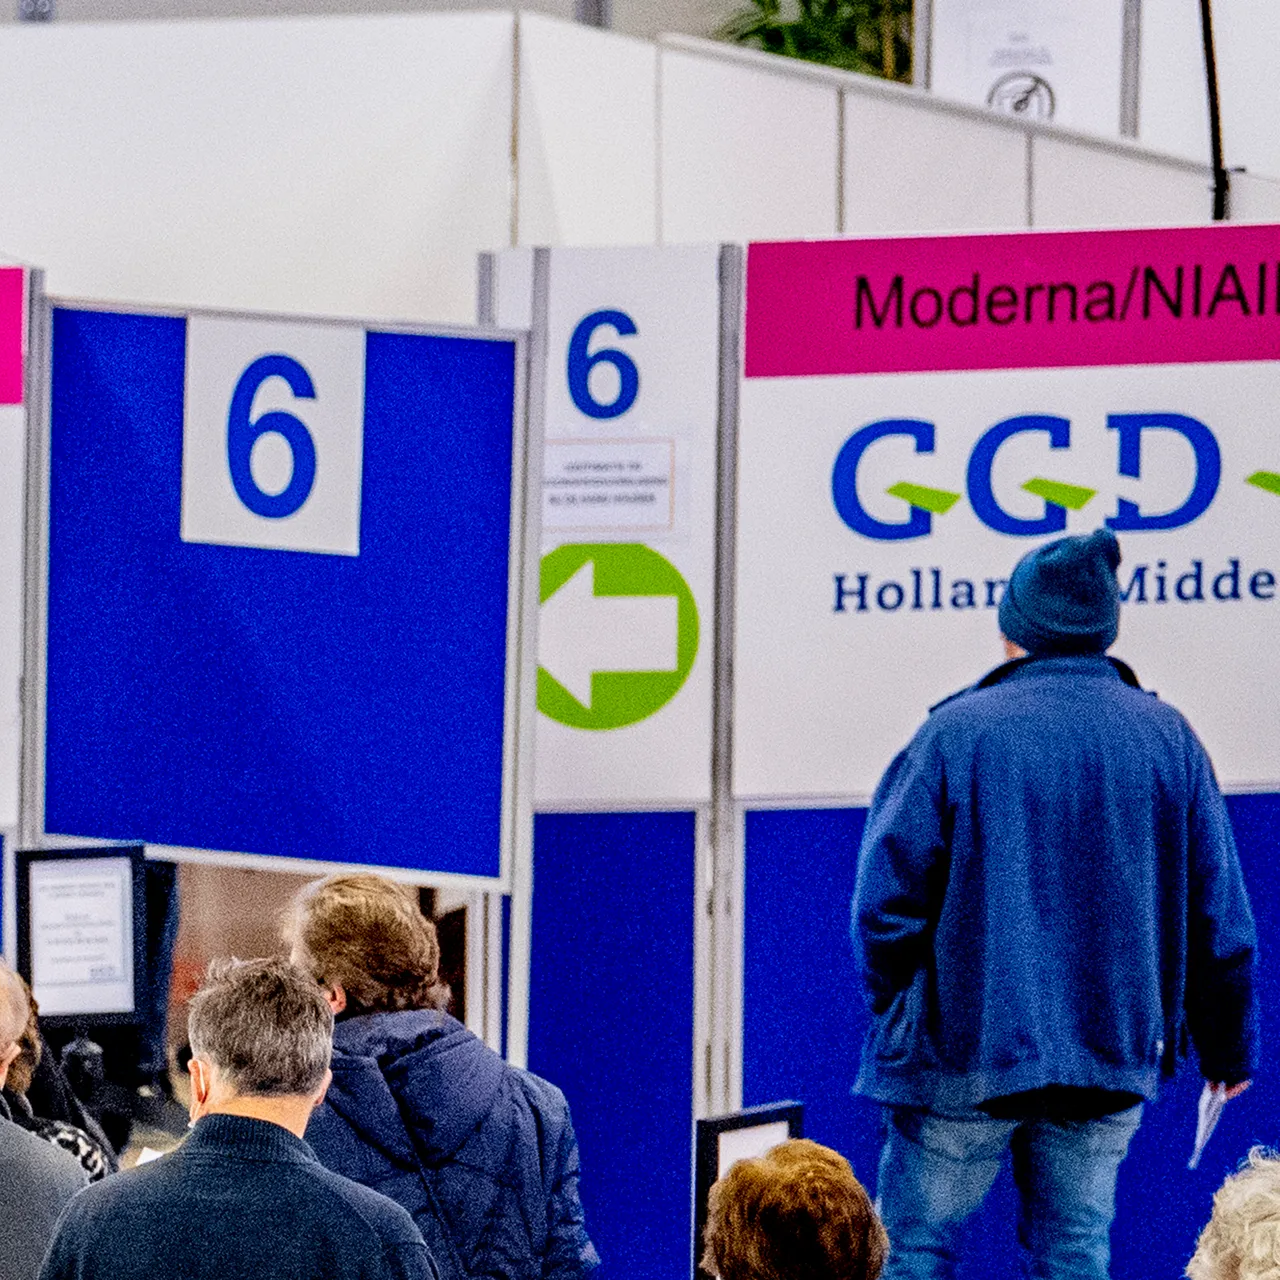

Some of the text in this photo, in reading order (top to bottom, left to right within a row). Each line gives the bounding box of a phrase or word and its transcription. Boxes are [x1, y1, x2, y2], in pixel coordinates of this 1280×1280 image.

[566, 310, 640, 419] 6
[226, 354, 317, 519] 6
[831, 412, 1222, 540] GGD
[833, 556, 1276, 613] Hollan Midde
